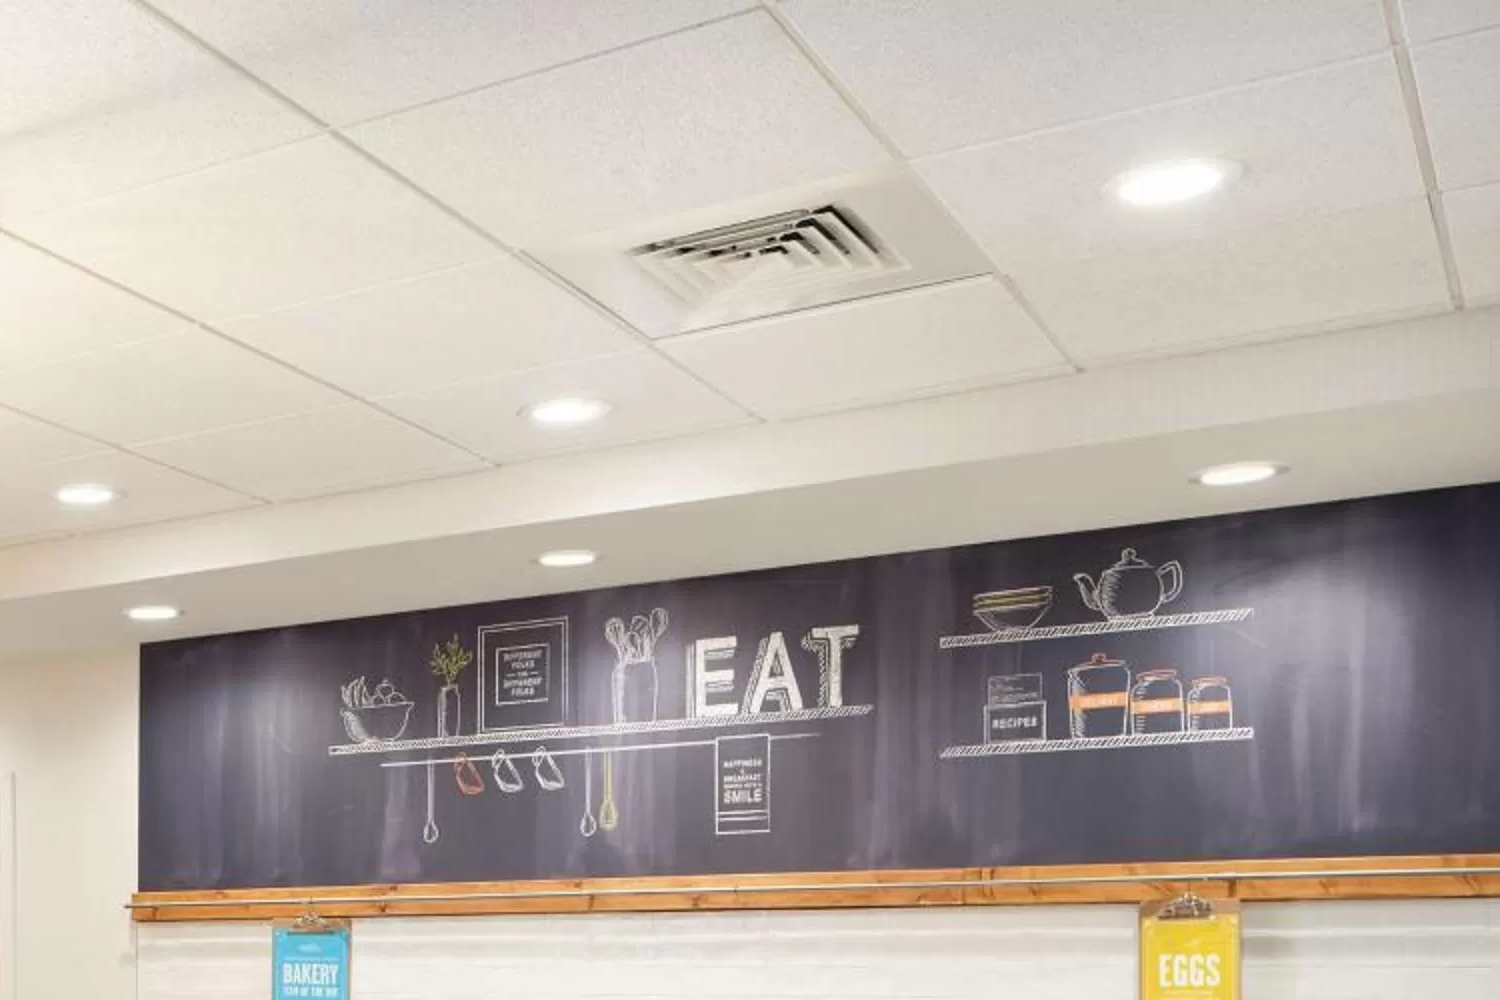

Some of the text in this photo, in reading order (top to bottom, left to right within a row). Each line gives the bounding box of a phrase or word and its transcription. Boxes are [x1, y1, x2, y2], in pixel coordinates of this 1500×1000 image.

[688, 624, 860, 719] EAT
[992, 716, 1038, 729] RECIPES
[724, 788, 762, 804] SMILE
[283, 963, 338, 985] BAKERY
[1158, 953, 1220, 988] EGGS
